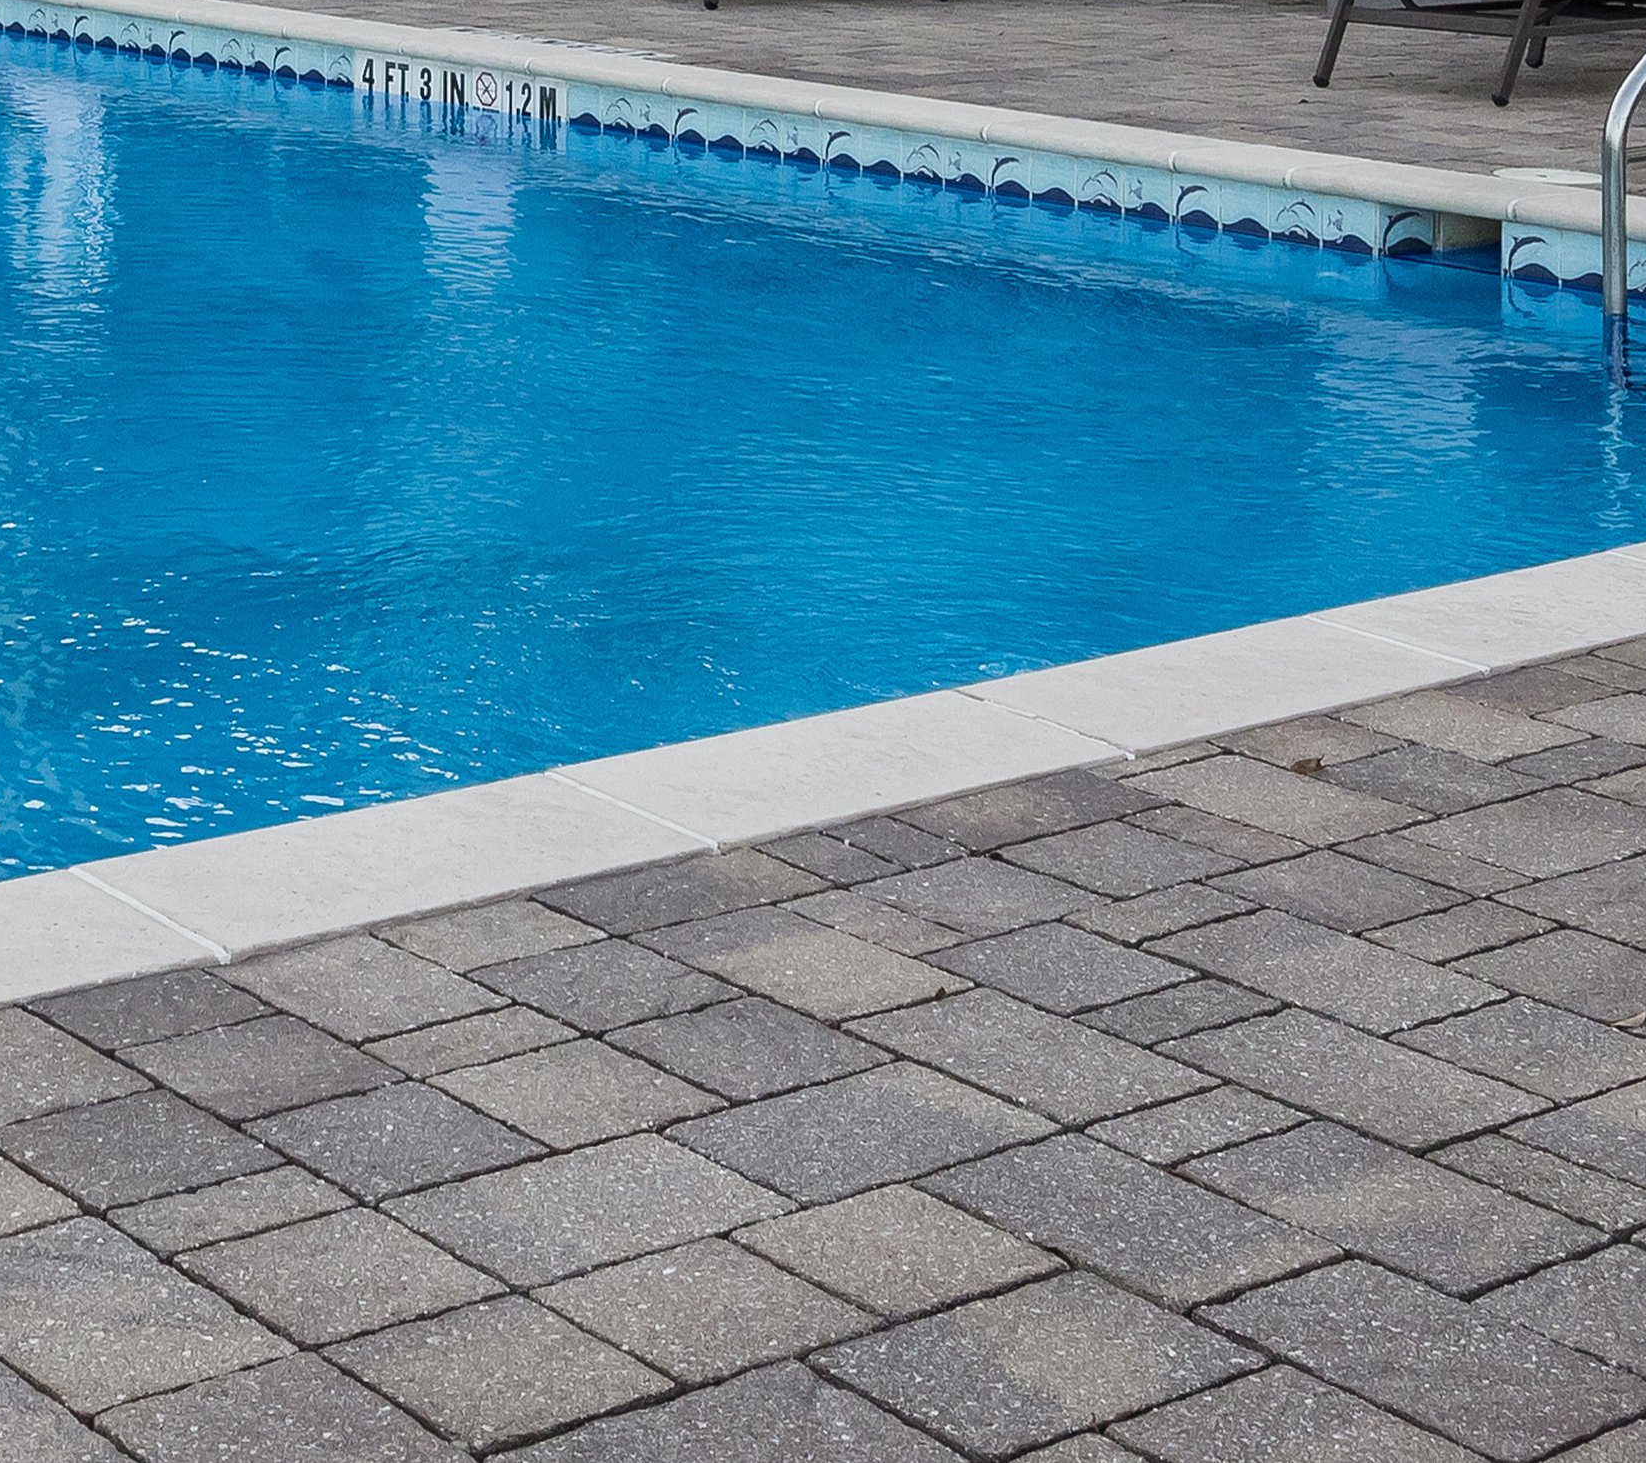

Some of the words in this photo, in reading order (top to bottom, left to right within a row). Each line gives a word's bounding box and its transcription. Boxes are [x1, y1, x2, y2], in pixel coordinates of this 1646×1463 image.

[362, 58, 375, 91] 4
[385, 60, 409, 98] FT.
[419, 67, 432, 100] 3
[443, 70, 469, 109] IN.
[505, 81, 532, 117] 1.2
